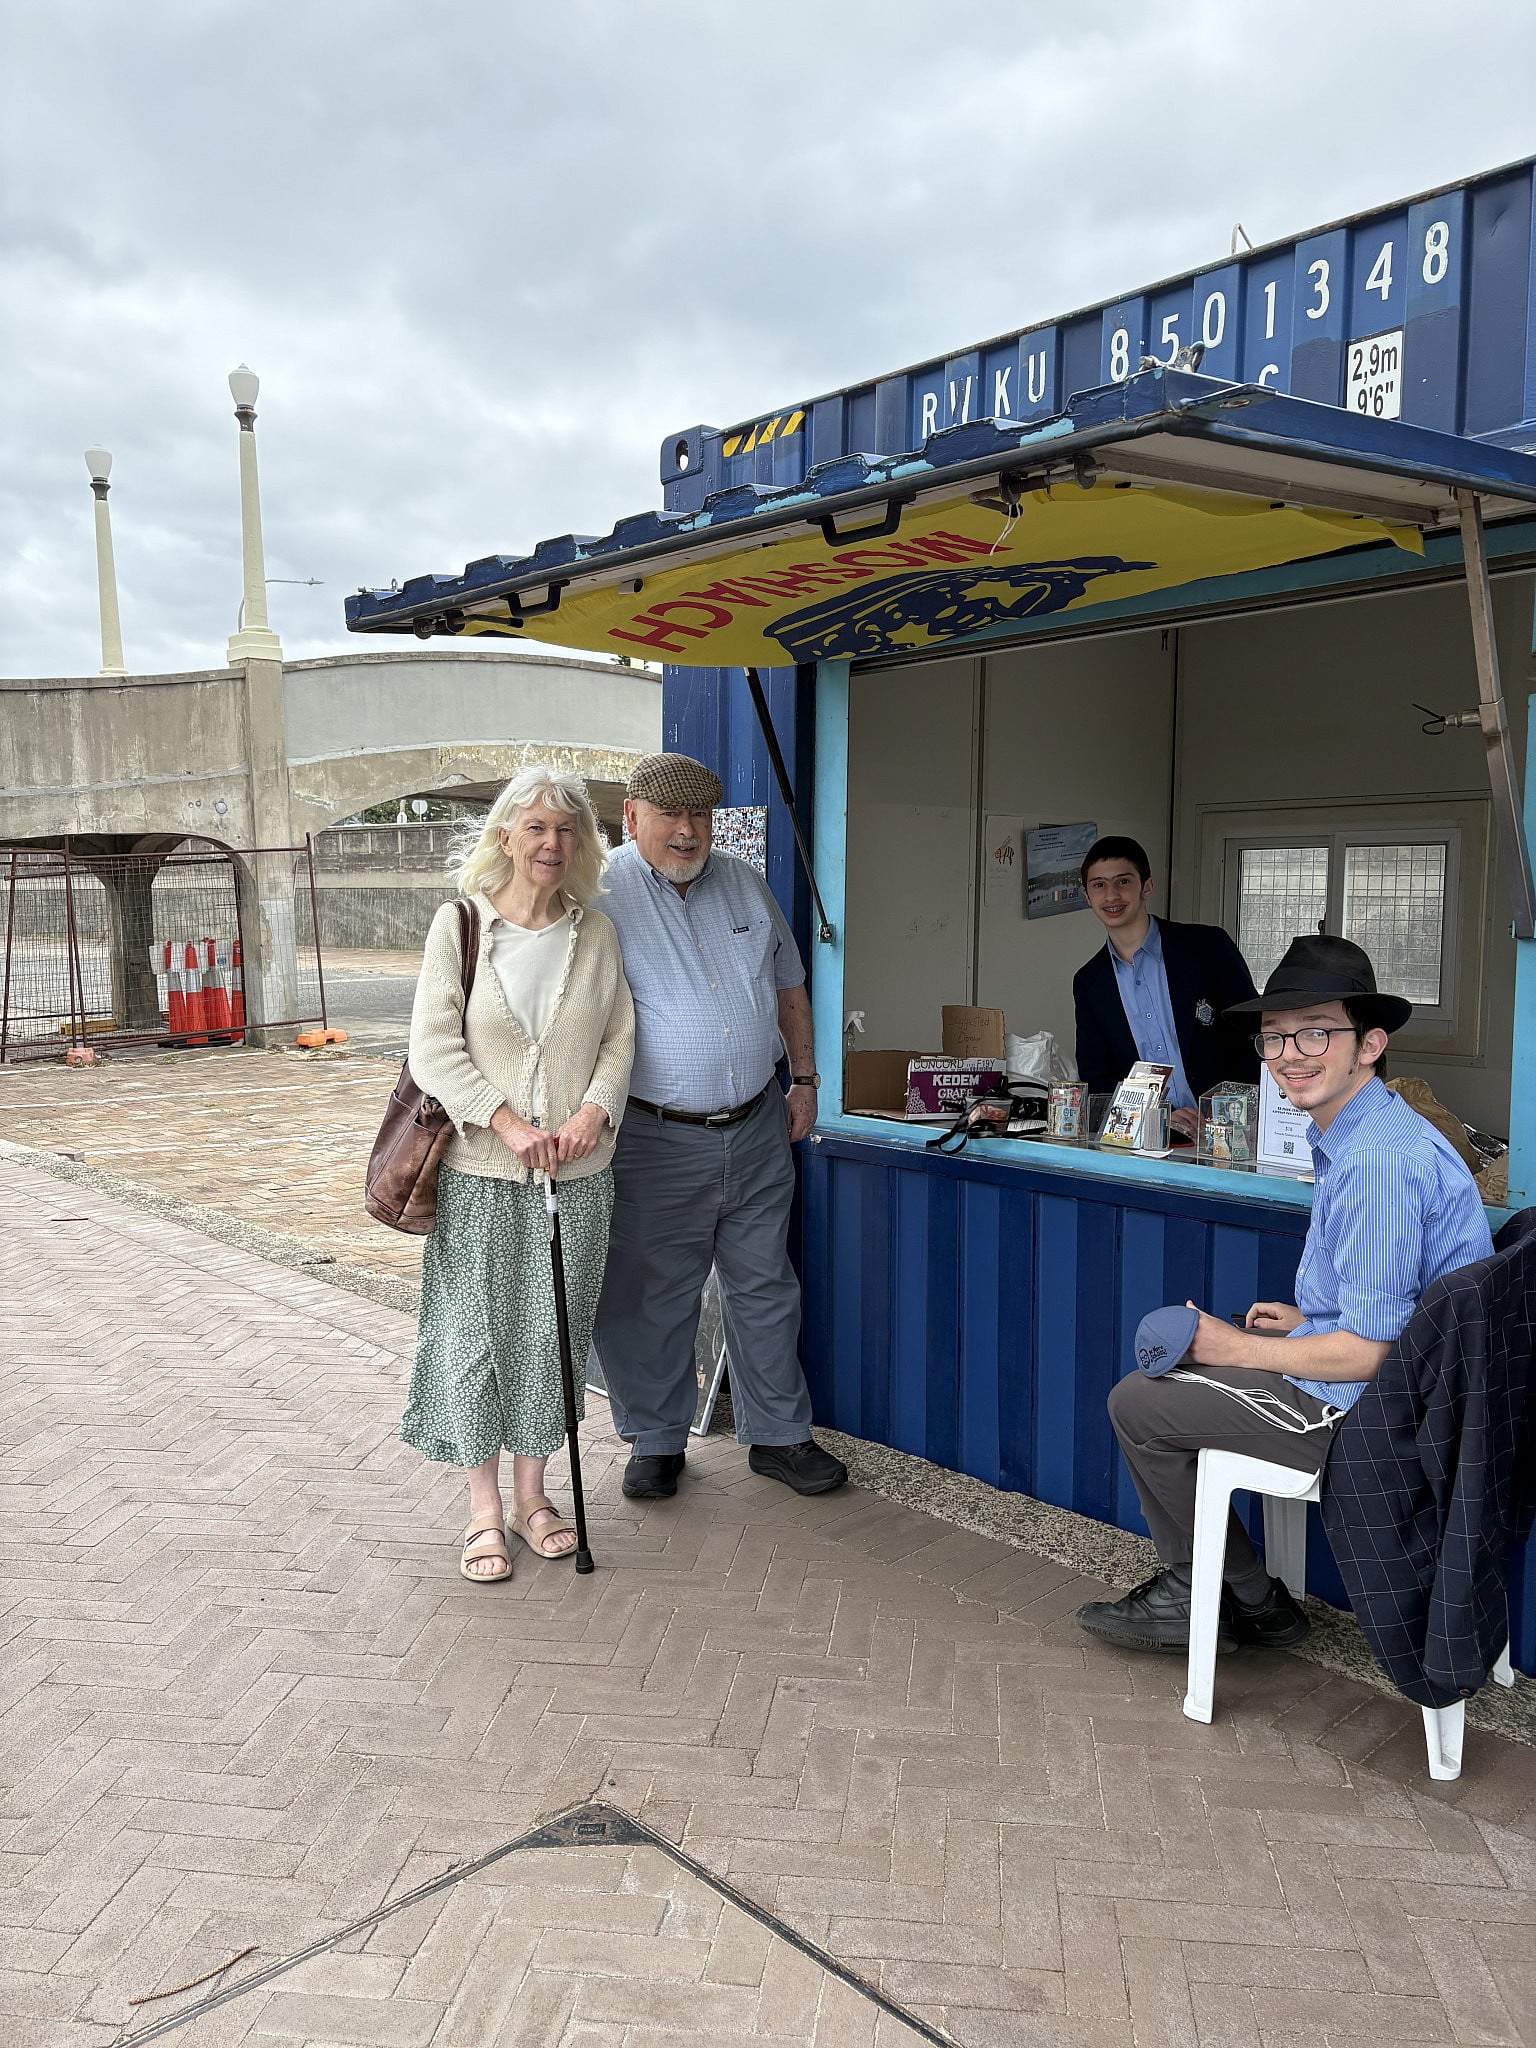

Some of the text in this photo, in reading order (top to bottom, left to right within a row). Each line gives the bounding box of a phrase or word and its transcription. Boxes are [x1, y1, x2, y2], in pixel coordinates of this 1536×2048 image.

[1352, 343, 1398, 385] 2,9m
[1357, 380, 1394, 416] 9'6"
[607, 530, 1014, 653] MOSHIACH
[932, 1074, 980, 1087] KEDEM
